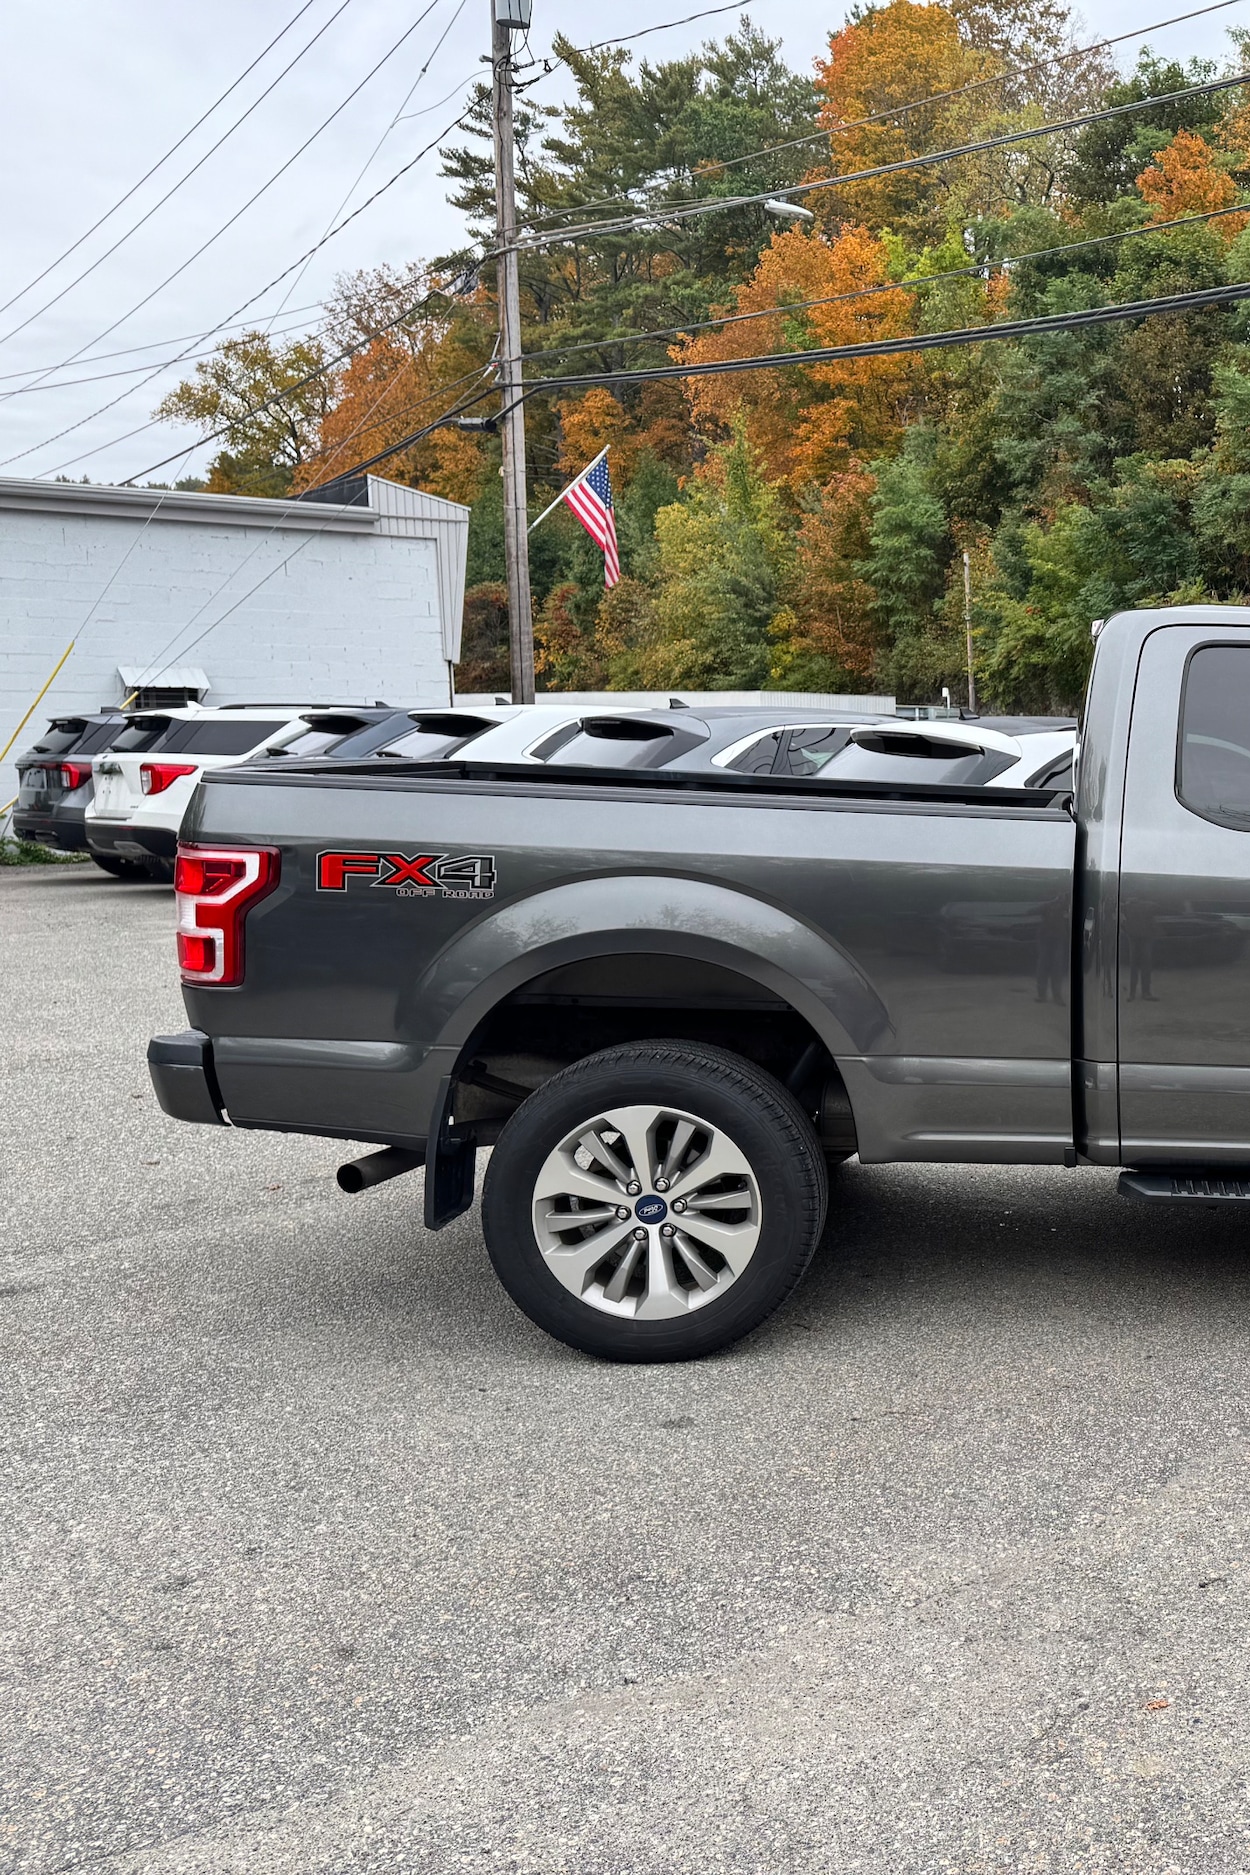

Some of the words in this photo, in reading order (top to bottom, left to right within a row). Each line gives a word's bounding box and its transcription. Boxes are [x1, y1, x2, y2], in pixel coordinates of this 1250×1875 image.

[316, 849, 496, 892] FX4
[396, 887, 435, 897] OFF
[442, 889, 494, 899] ROAD
